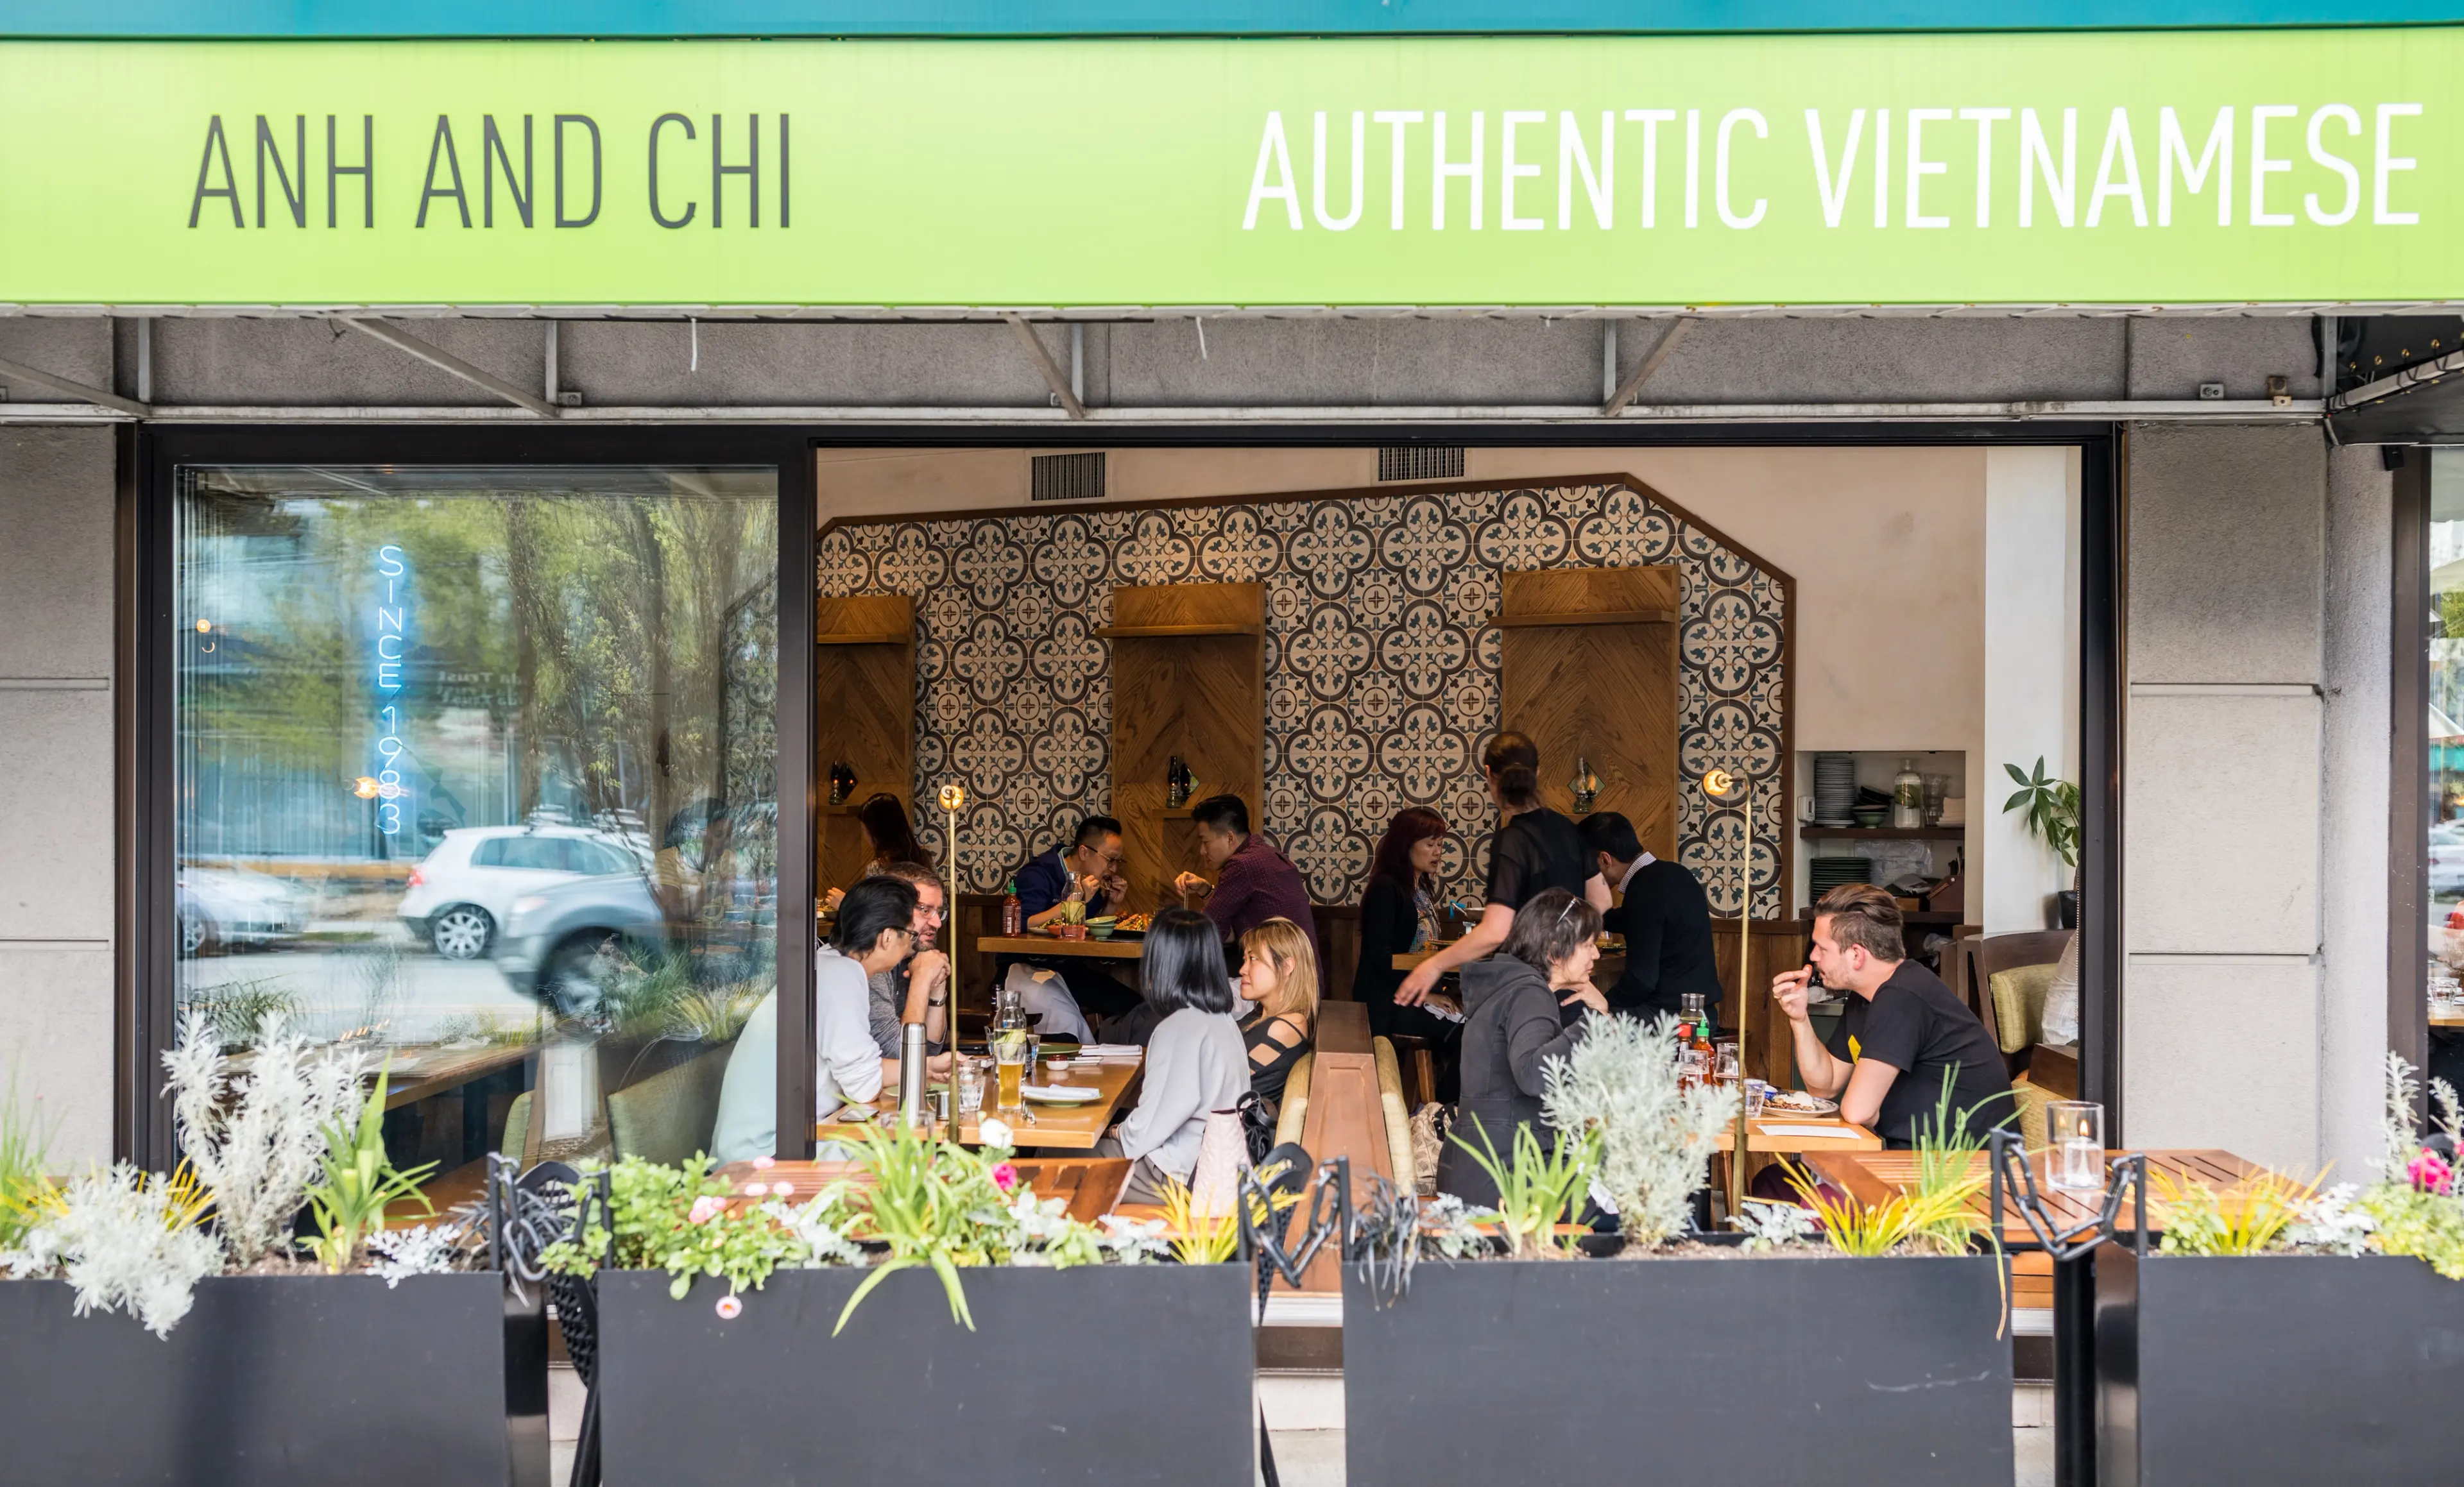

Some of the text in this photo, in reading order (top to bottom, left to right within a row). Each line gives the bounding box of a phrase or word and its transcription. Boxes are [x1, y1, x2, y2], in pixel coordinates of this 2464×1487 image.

[187, 112, 790, 230] ANH AND CHI
[1242, 103, 2423, 231] AUTHENTIC VIETNAMESE
[378, 545, 404, 835] SINCE 1983
